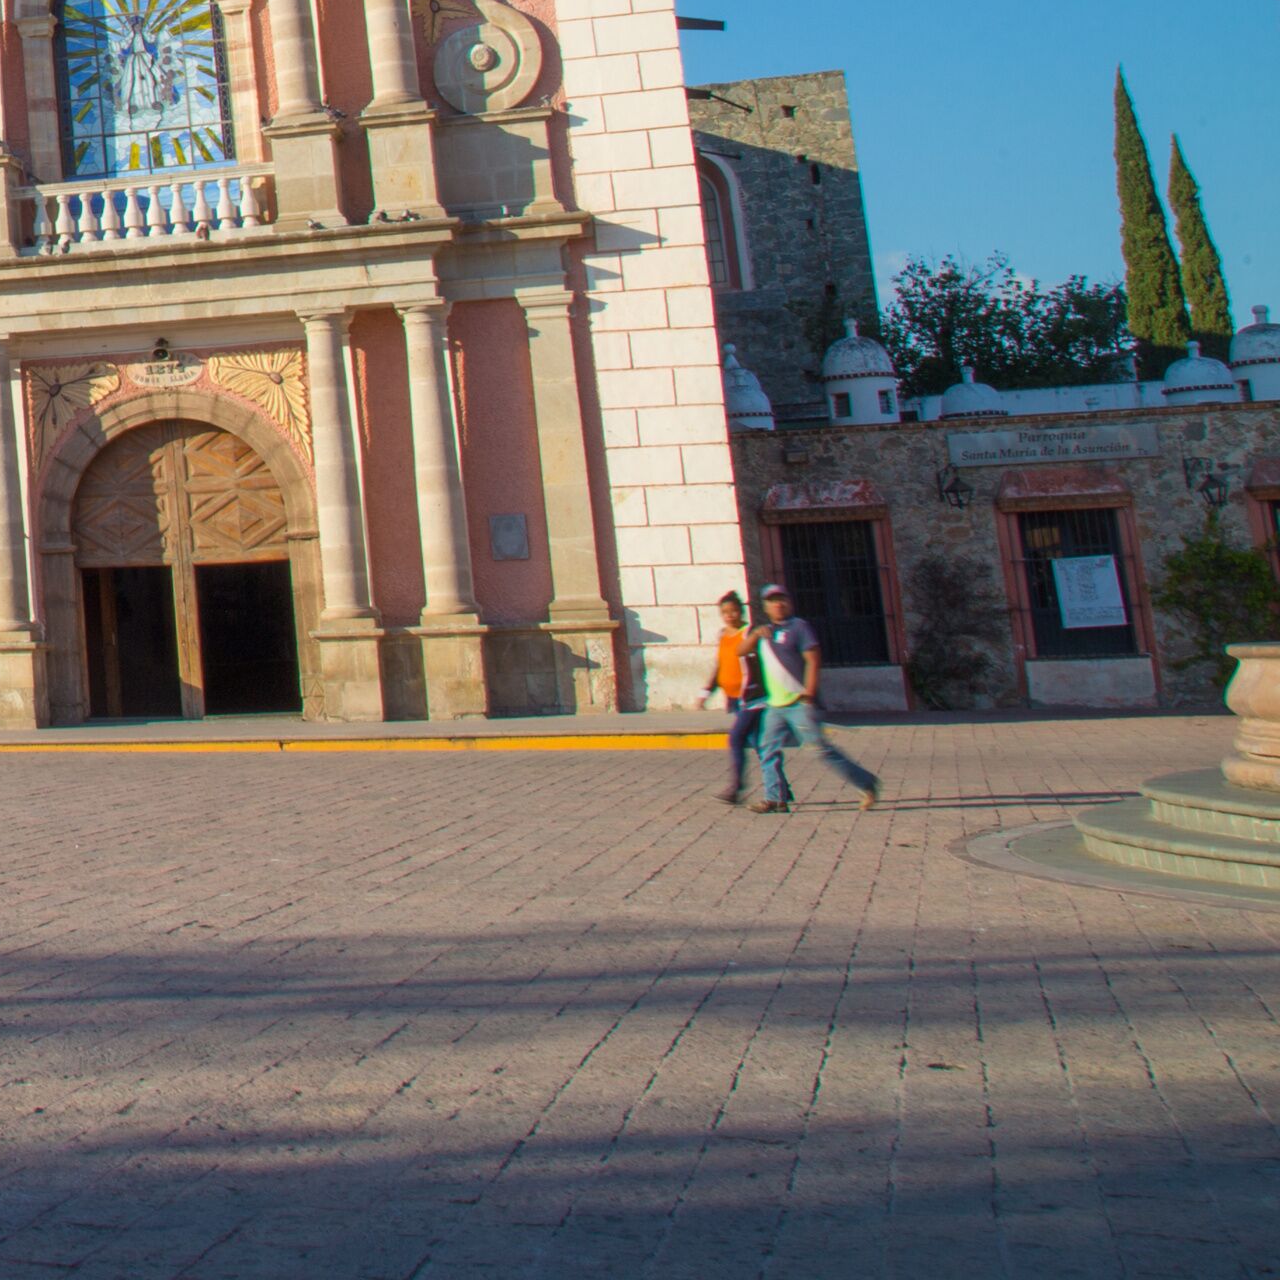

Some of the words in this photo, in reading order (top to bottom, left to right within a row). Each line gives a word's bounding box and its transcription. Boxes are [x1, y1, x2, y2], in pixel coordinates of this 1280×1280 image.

[1018, 431, 1086, 445] Parroquia
[961, 449, 997, 461] Santa
[999, 446, 1037, 459] María
[1040, 445, 1055, 457] de
[1057, 444, 1069, 456] la
[1072, 442, 1130, 455] Asunción
